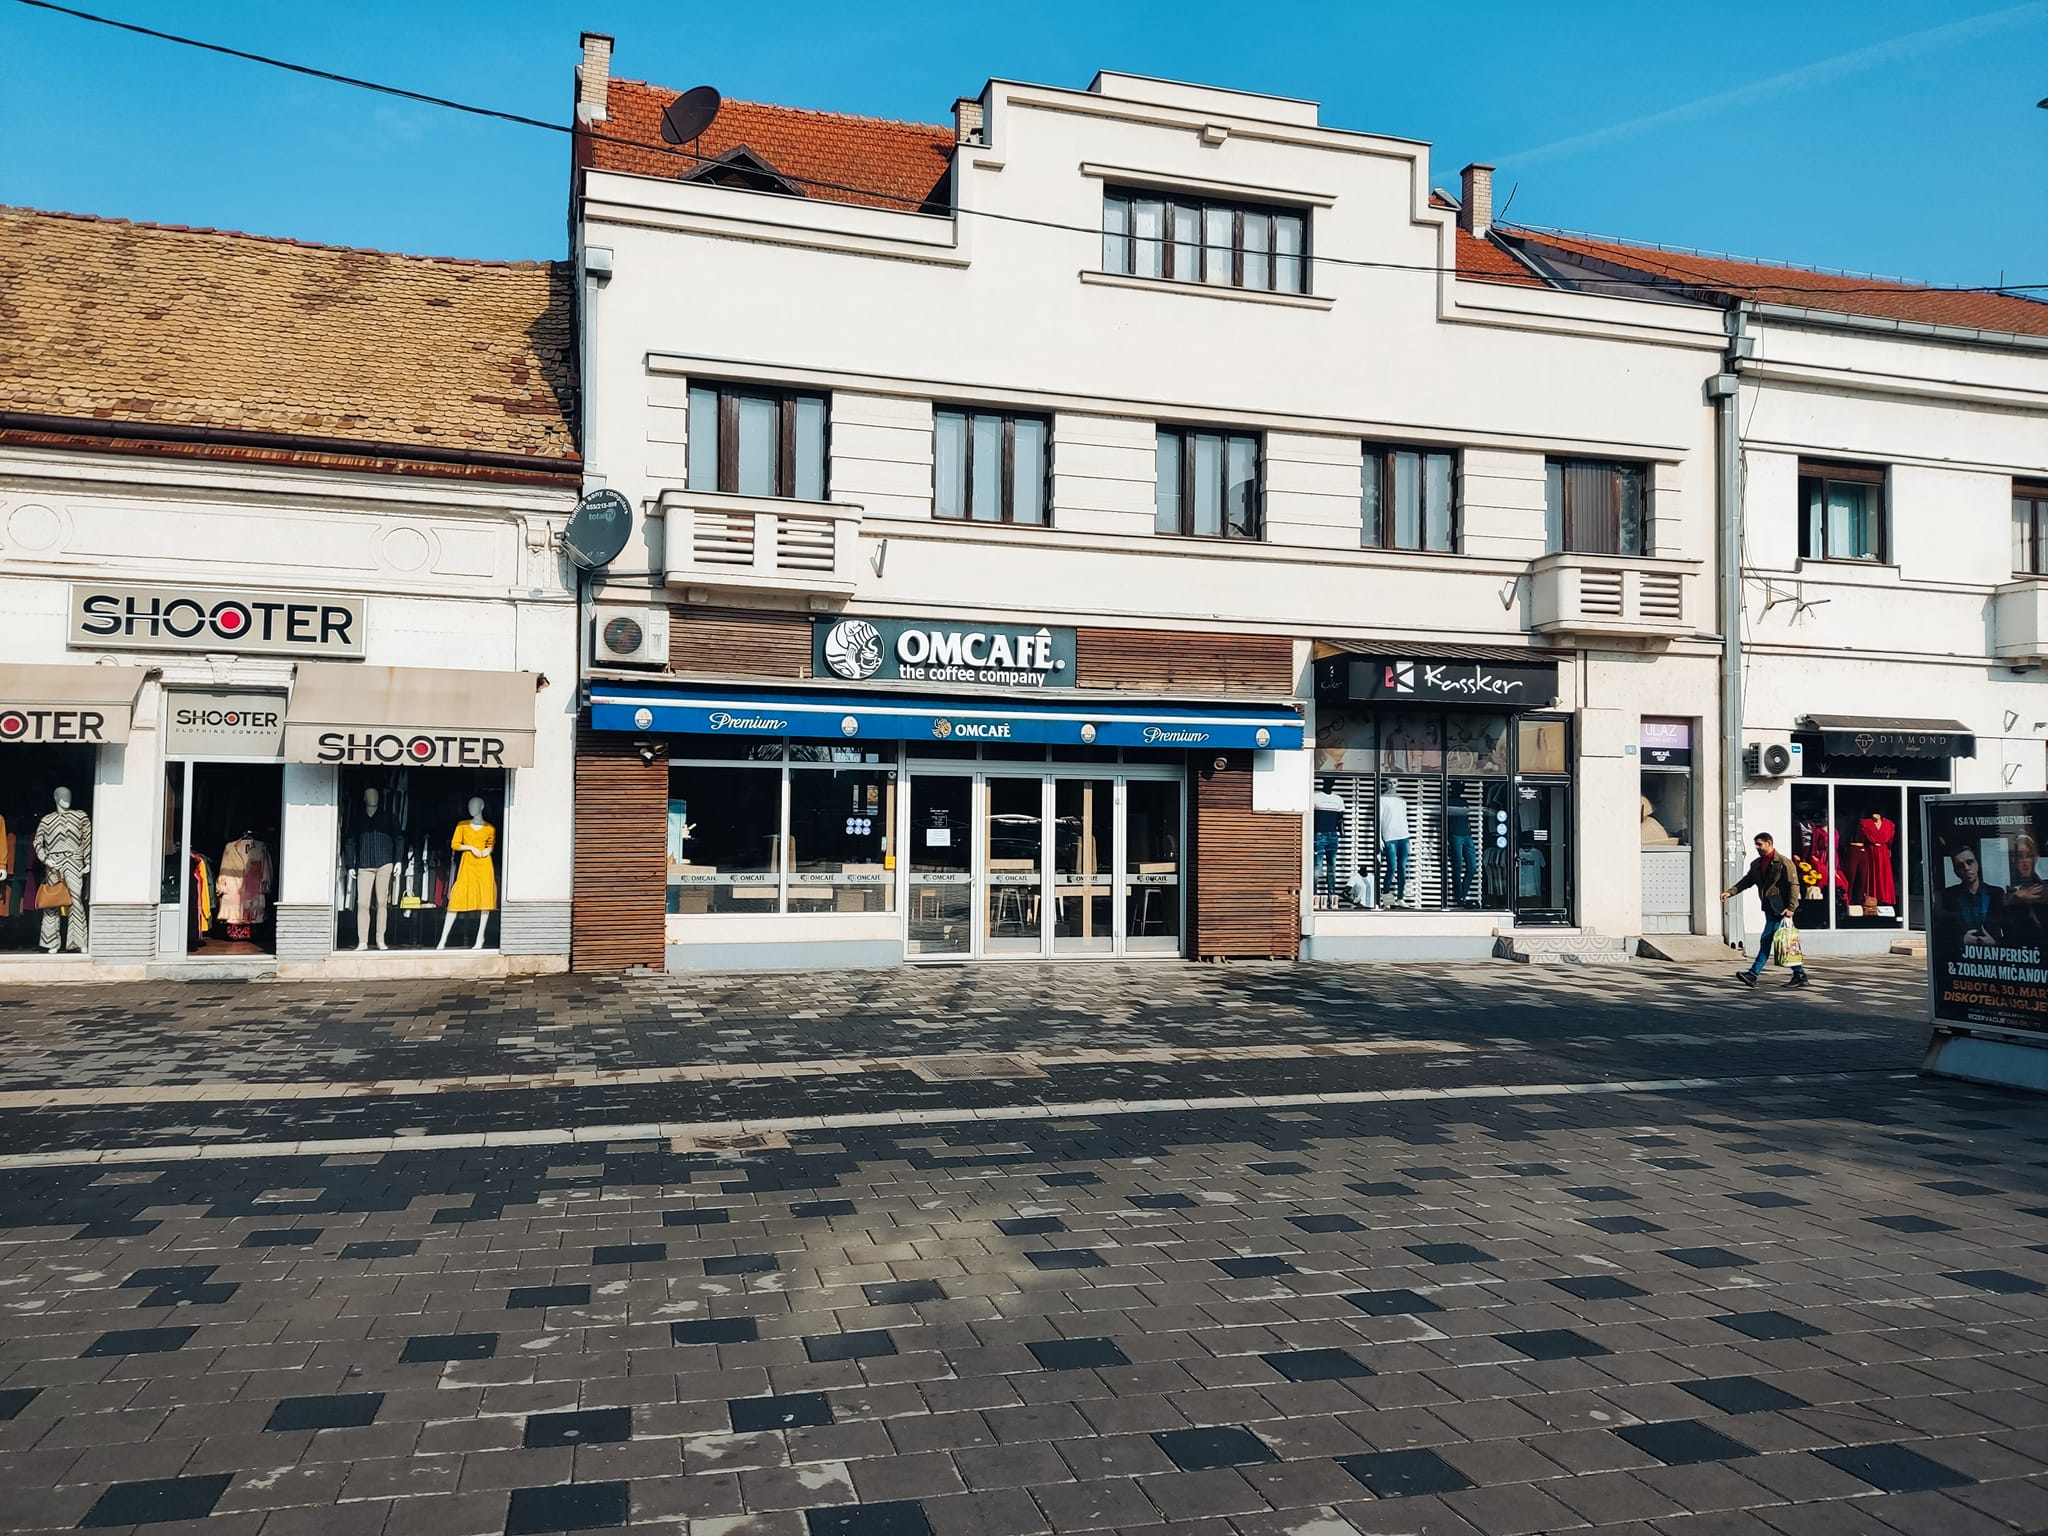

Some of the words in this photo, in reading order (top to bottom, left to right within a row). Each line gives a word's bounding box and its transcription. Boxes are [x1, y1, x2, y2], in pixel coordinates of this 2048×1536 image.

[81, 595, 352, 644] SHOOTER
[899, 664, 925, 679] the
[929, 665, 975, 682] coffee
[979, 670, 1045, 687] company
[1424, 664, 1523, 694] Kassker
[176, 709, 278, 727] SHOOTER
[709, 711, 788, 730] Premium
[1143, 726, 1210, 743] Premium
[1645, 724, 1677, 737] ULAZ
[317, 732, 504, 765] SHOOTER
[1880, 735, 1947, 745] DIAMOND
[1962, 945, 1998, 960] JOVAN
[1948, 962, 1957, 975] &
[1957, 962, 1997, 979] ZORANA
[1944, 991, 2008, 1007] DISKOTEKA
